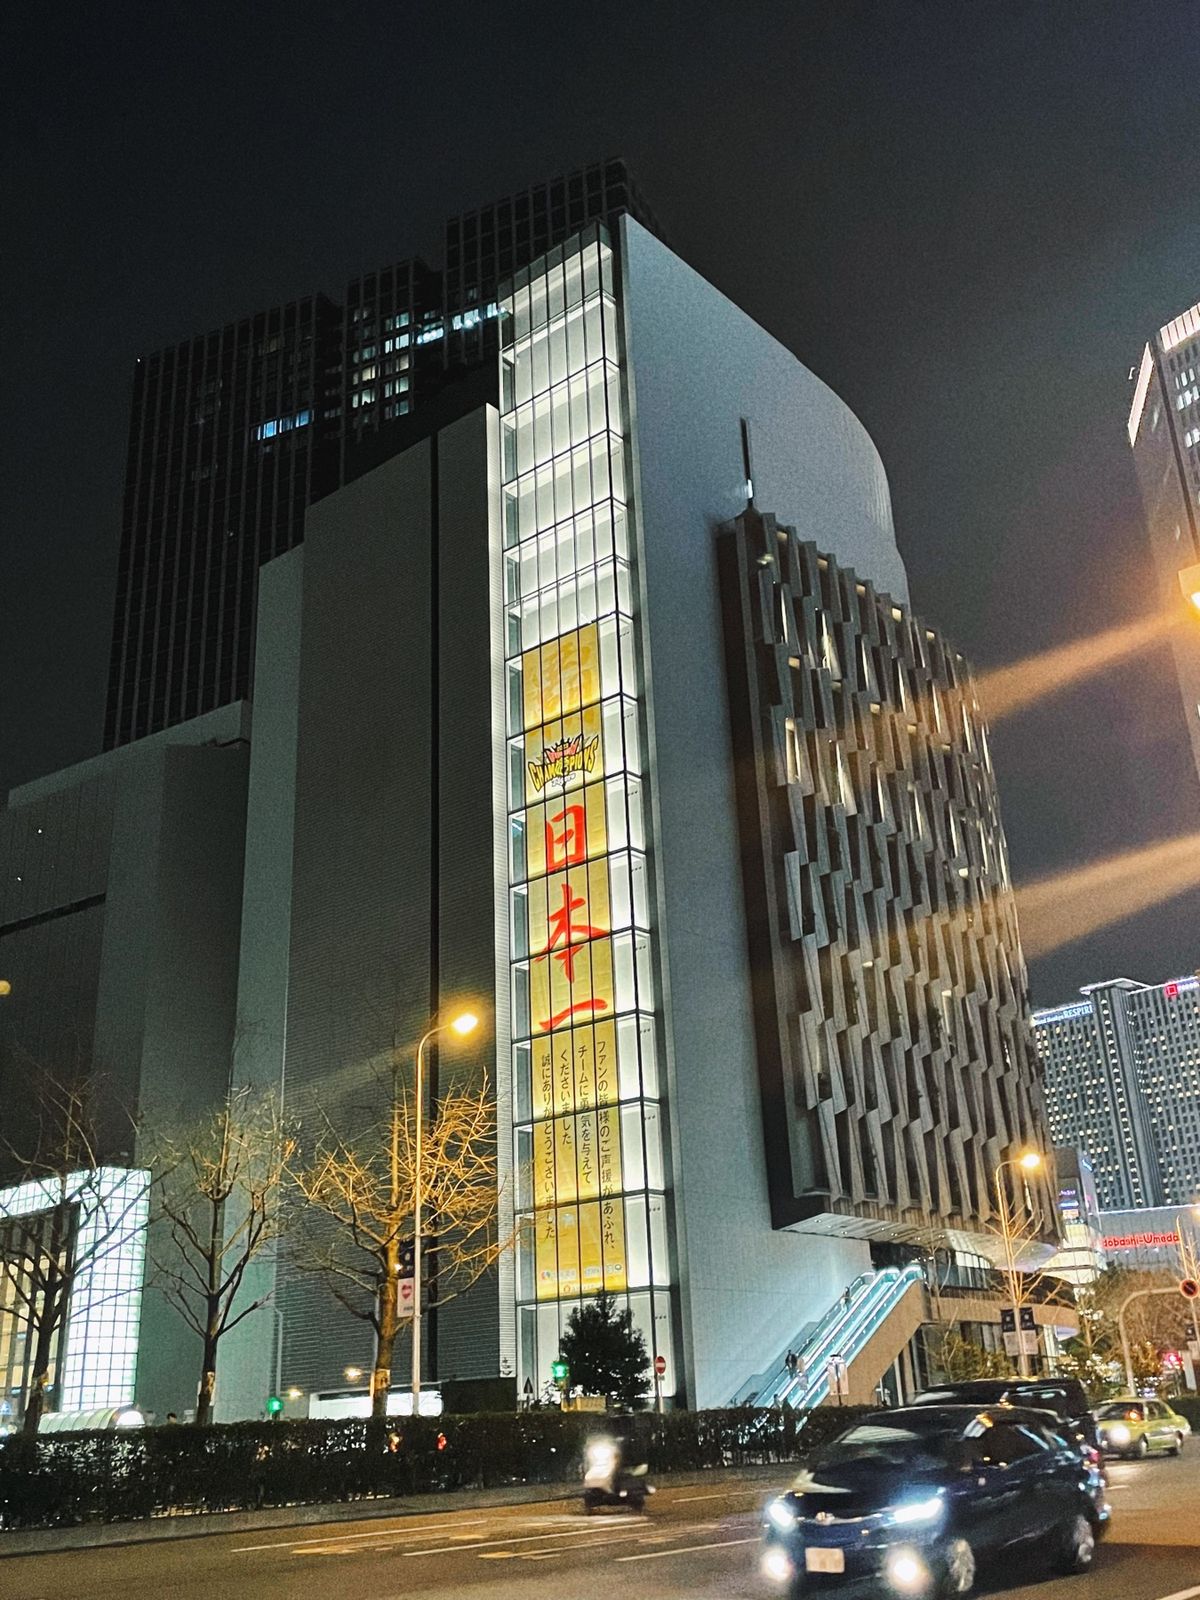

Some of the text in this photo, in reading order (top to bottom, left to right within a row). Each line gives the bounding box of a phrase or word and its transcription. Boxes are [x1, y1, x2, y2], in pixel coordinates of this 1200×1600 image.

[528, 735, 599, 792] CHAMPIONS
[533, 804, 610, 1032] 日本一
